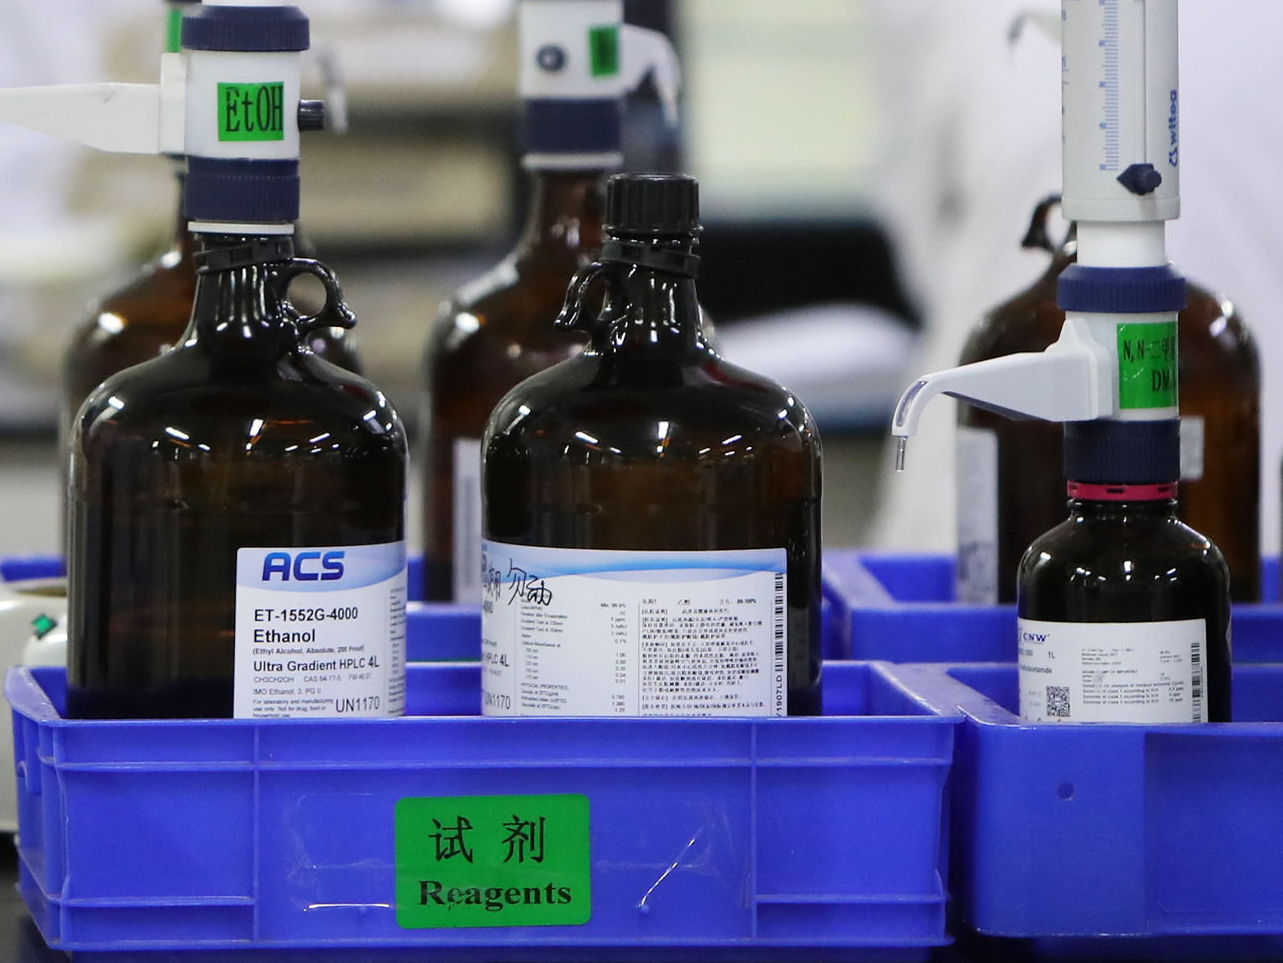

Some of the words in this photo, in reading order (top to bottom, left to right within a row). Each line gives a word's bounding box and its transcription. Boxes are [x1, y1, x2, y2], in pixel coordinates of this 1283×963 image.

[225, 86, 284, 132] EtOH
[262, 551, 345, 581] ACS
[254, 607, 358, 622] ET-1552G-4000
[254, 629, 315, 642] Ethanol
[1023, 632, 1046, 642] CNW
[254, 661, 283, 671] Ultra
[287, 660, 336, 671] Gradient
[339, 658, 365, 669] HPLC
[368, 656, 380, 668] 4L
[336, 696, 380, 712] UN1170
[428, 814, 545, 864] 试剂
[418, 880, 572, 912] Reagents
